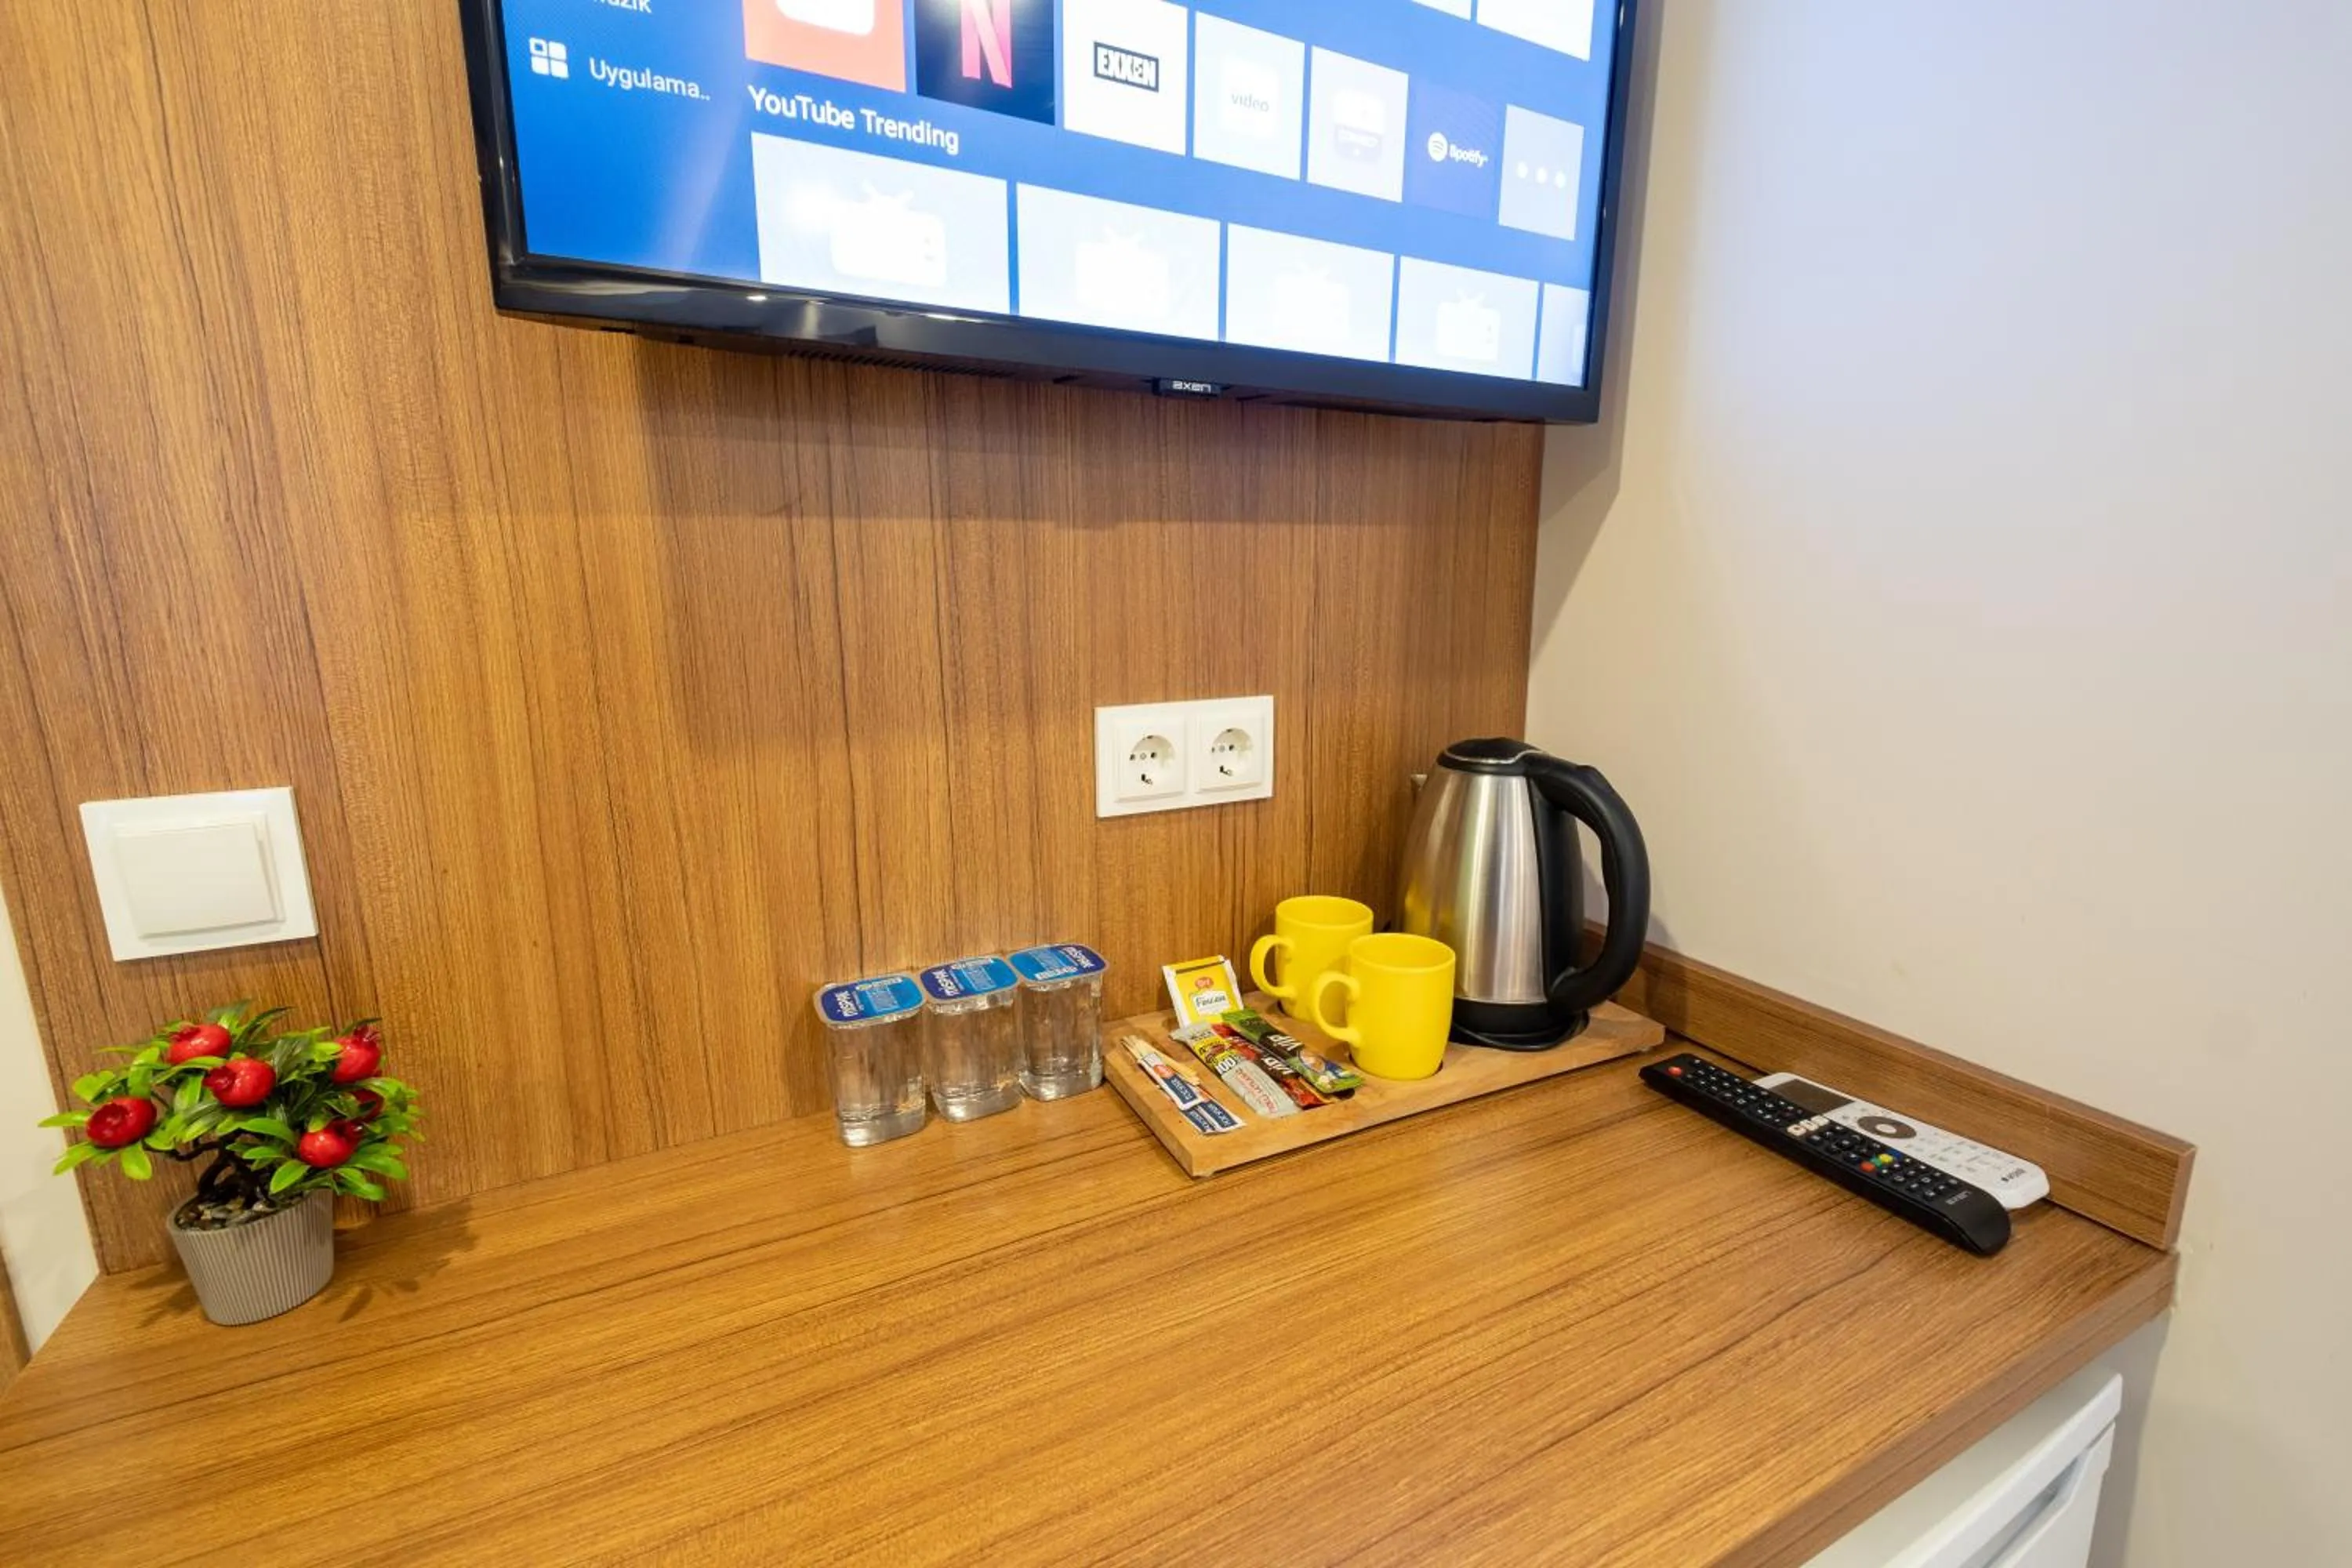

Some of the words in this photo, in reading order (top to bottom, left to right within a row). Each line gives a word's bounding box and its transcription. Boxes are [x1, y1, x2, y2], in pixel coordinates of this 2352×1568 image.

[1097, 46, 1156, 89] EXXEN
[747, 84, 855, 129] YouTube
[859, 108, 959, 155] Trending
[1231, 93, 1270, 112] video
